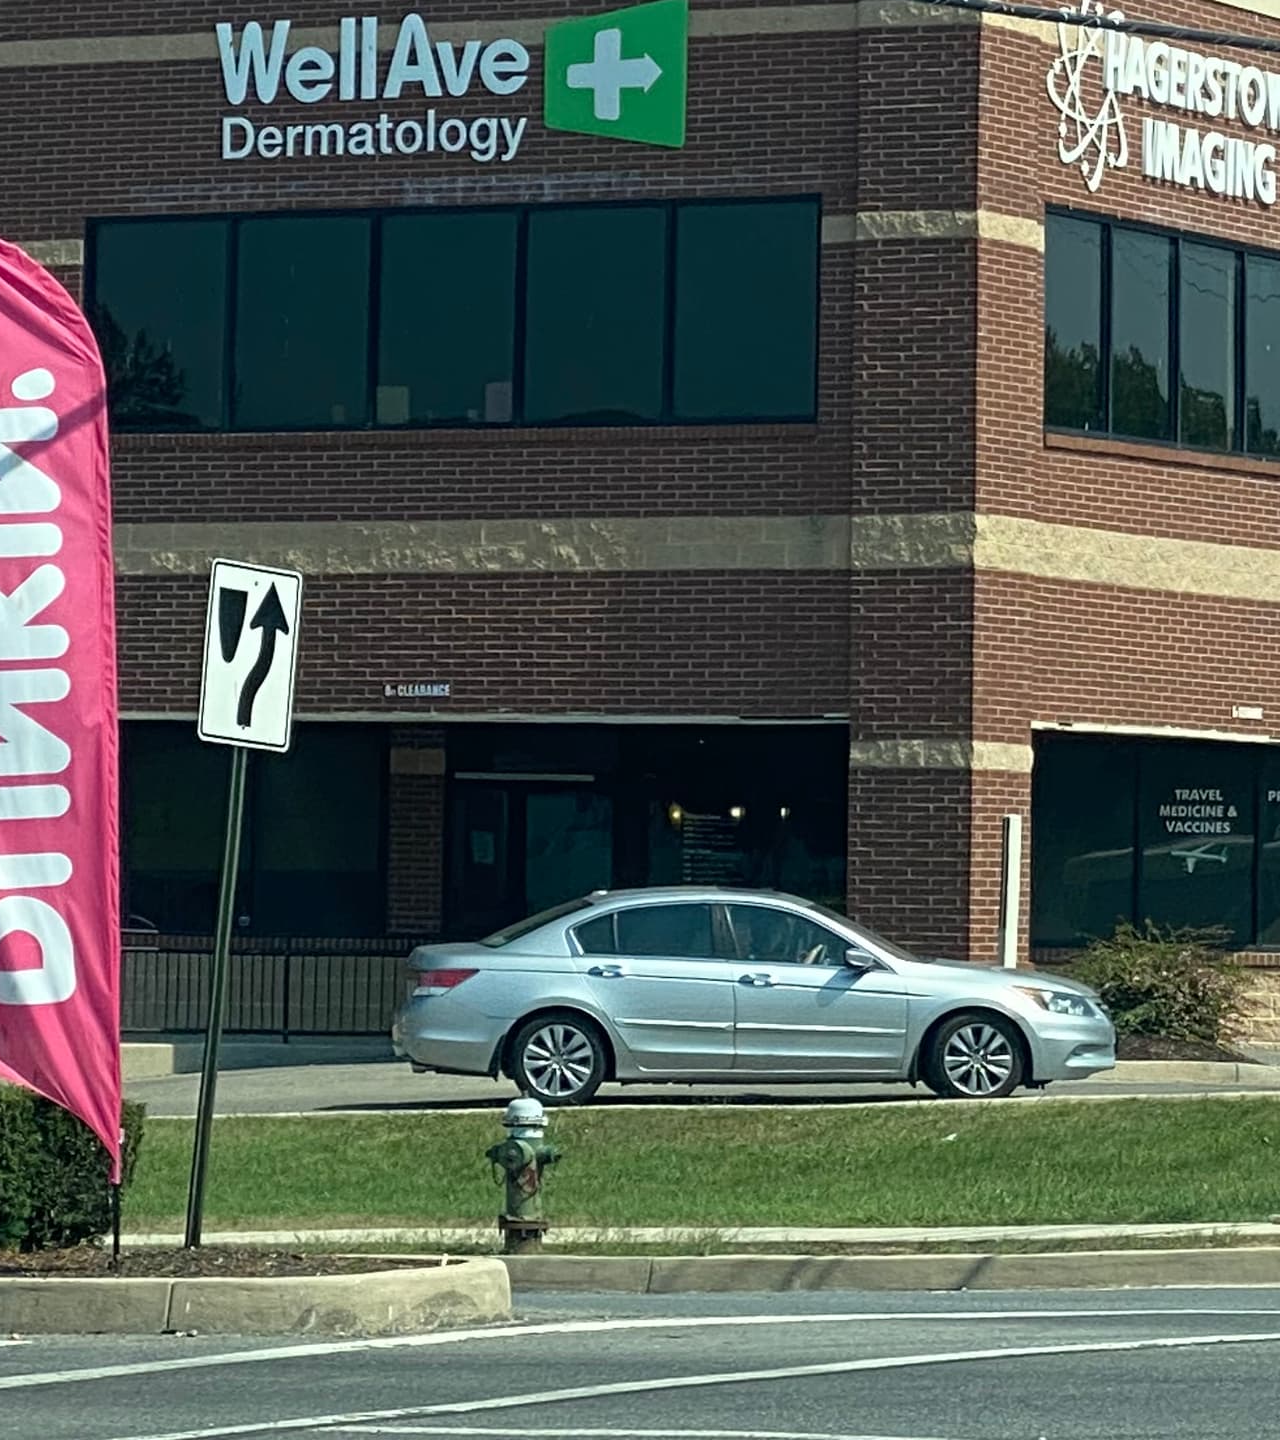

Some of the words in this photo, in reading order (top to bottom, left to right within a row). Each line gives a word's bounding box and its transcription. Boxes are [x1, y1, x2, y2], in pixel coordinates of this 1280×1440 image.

[215, 12, 531, 106] WellAve
[221, 108, 528, 162] Dermatology
[1141, 117, 1278, 205] IMAGING
[1159, 805, 1223, 817] MEDICINE
[1227, 805, 1238, 818] &
[1175, 789, 1223, 801] TRAVEL
[1165, 820, 1231, 833] VACCINES
